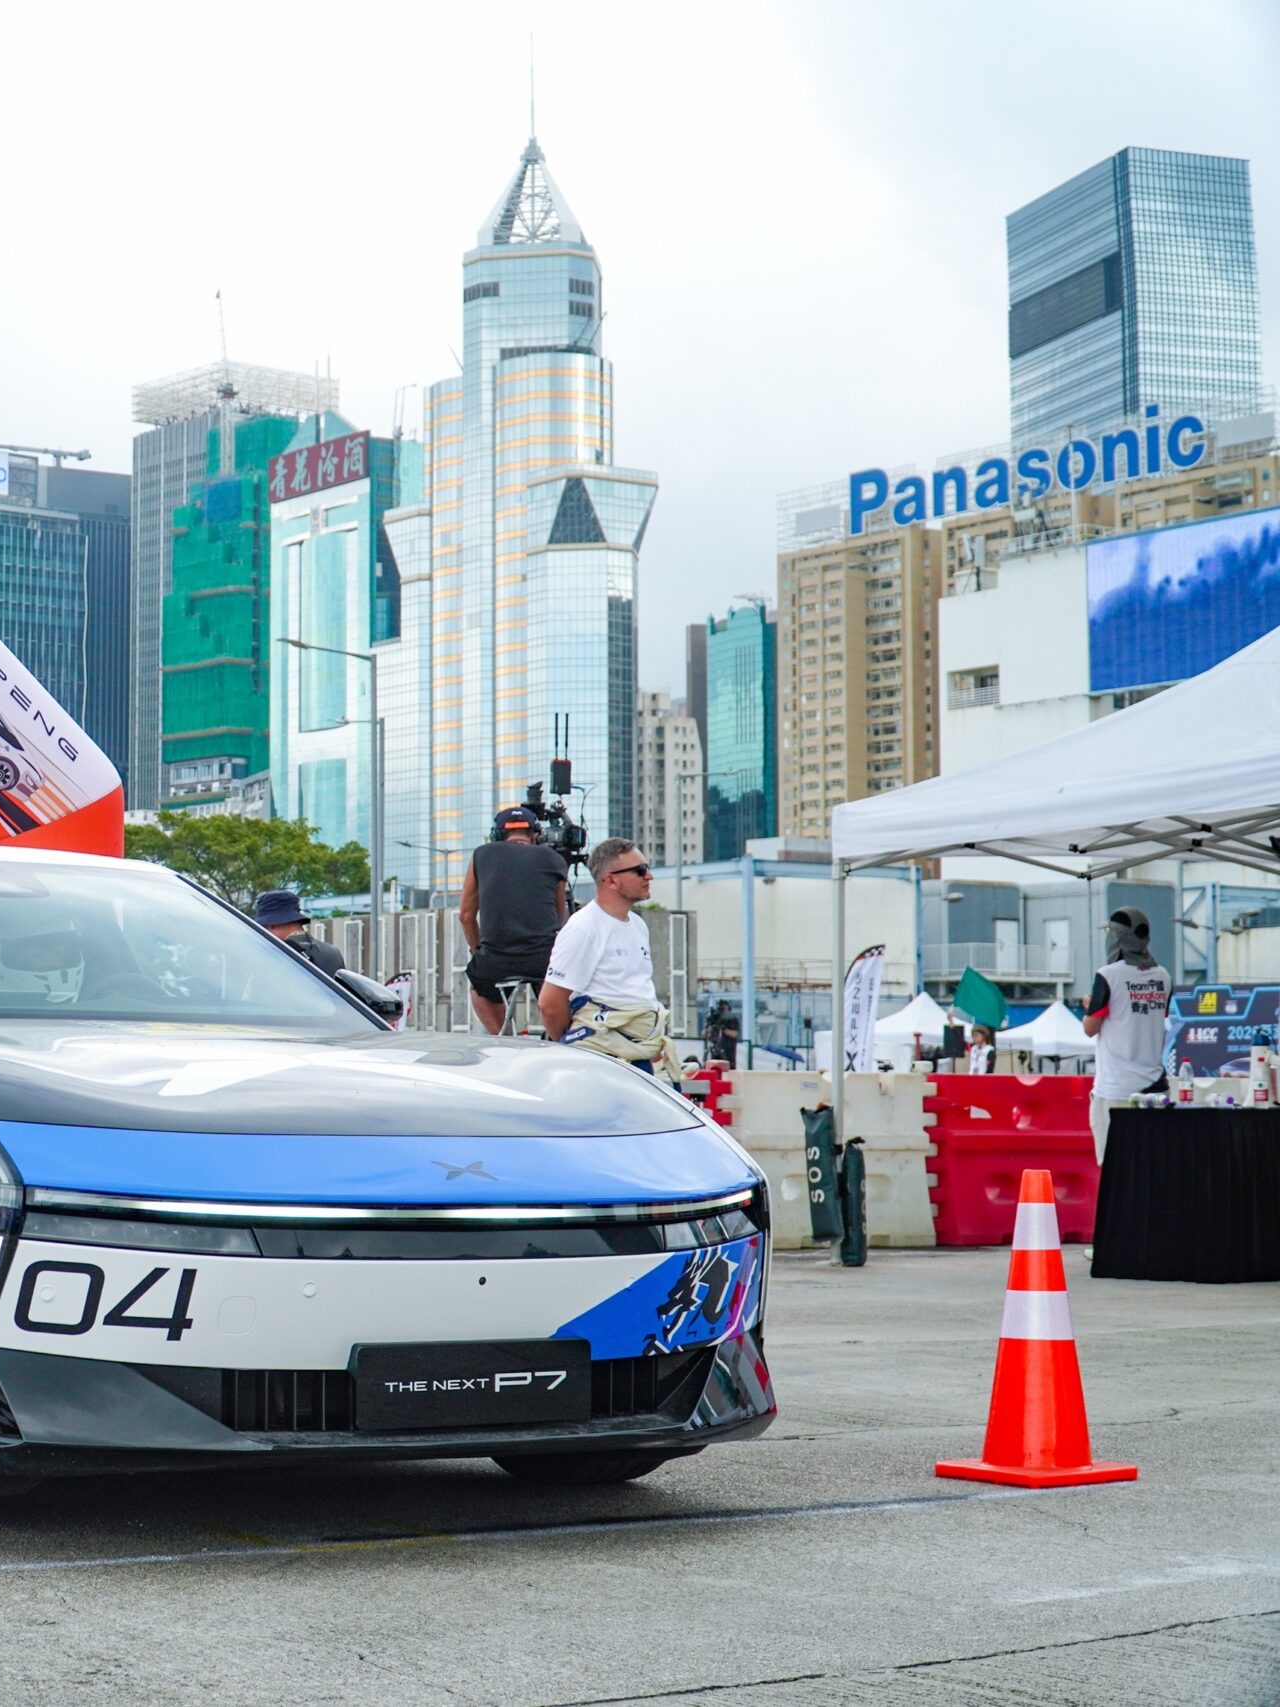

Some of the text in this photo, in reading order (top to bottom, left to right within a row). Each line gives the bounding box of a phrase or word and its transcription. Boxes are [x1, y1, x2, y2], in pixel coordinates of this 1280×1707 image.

[850, 403, 1205, 536] Panasonic
[807, 1146, 825, 1203] SOS
[14, 1260, 198, 1342] 04
[384, 1370, 568, 1393] THE NEXT P7
